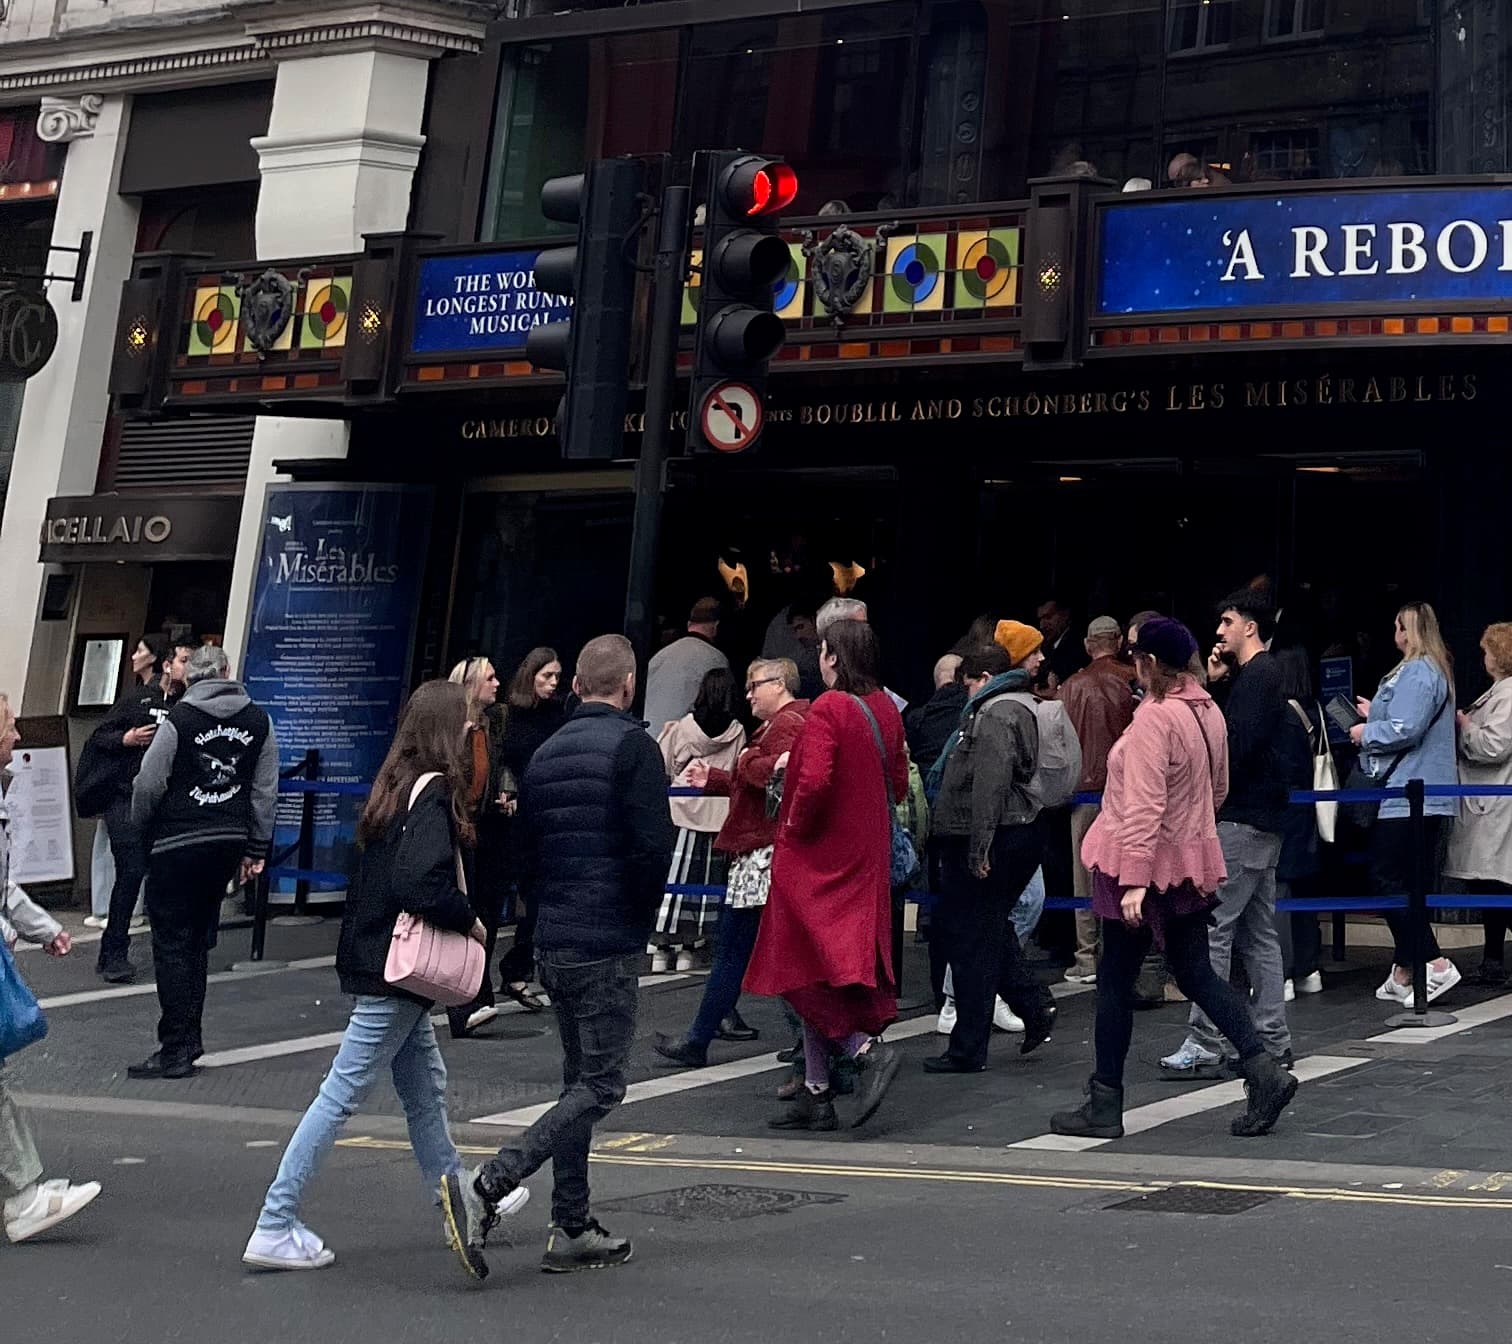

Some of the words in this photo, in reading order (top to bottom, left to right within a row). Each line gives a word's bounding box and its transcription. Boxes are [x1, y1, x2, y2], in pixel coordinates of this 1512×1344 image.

[454, 273, 491, 294] THE
[425, 293, 510, 317] LONGEST
[515, 291, 576, 311] RUNN
[800, 402, 901, 425] BOUBLIL
[910, 398, 962, 420] AND
[971, 390, 1150, 418] SCHÖNBERG'S
[1167, 384, 1225, 411] LES
[1246, 372, 1478, 407] MISÉRABLES
[315, 538, 346, 561] Les
[276, 553, 399, 584] Misérables
